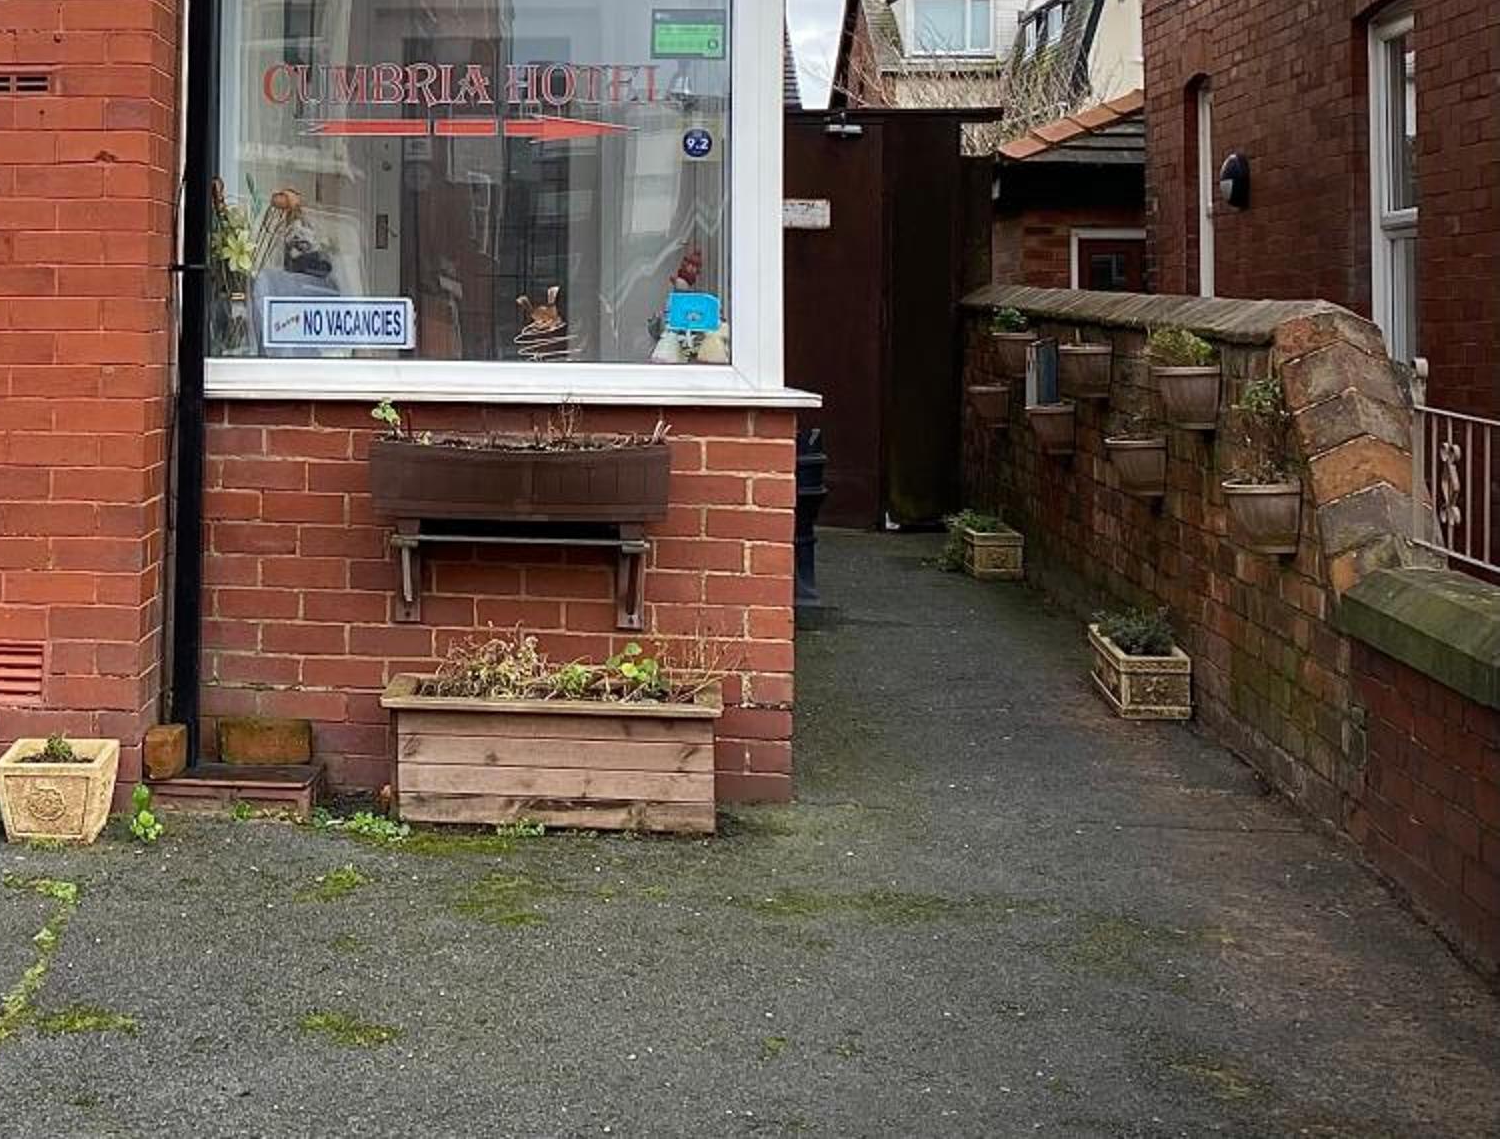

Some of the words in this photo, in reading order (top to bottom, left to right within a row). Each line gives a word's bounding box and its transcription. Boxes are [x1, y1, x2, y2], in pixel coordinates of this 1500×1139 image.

[263, 62, 494, 108] CUMBRIA
[685, 138, 710, 150] 9.2
[303, 309, 323, 336] NO
[326, 309, 402, 337] VACANCIES
